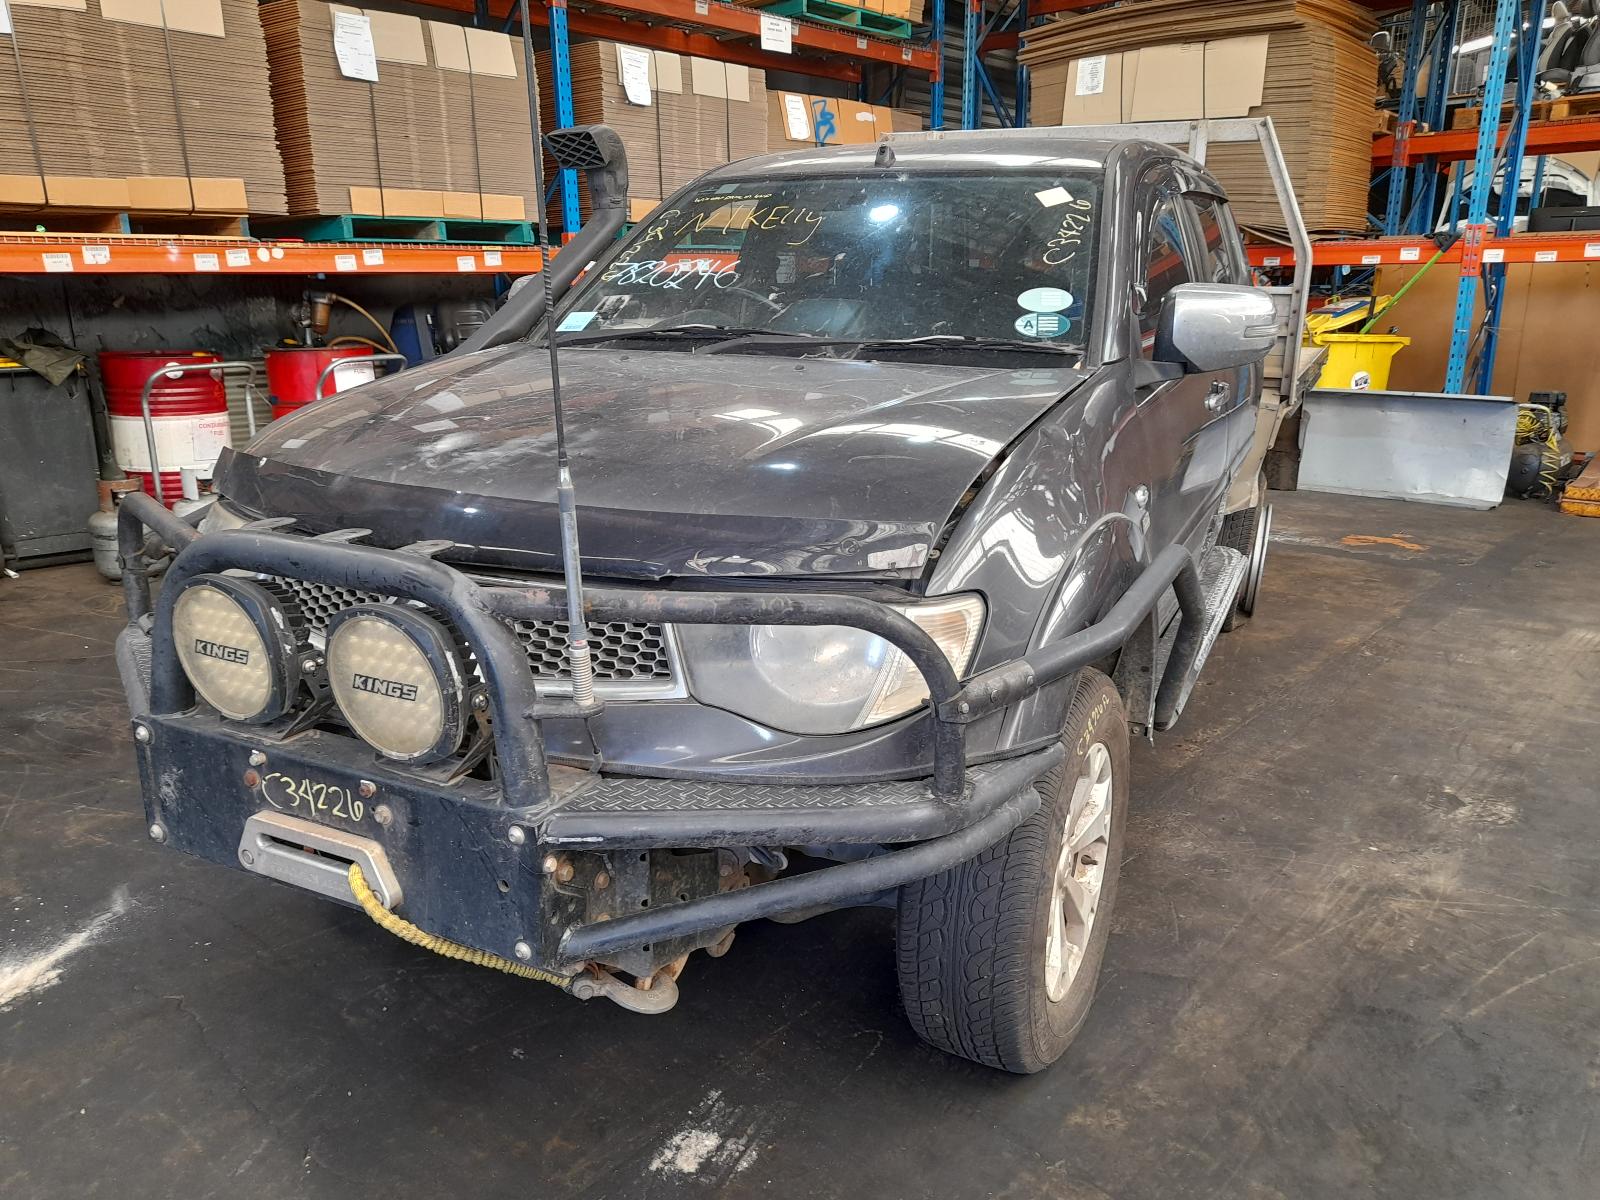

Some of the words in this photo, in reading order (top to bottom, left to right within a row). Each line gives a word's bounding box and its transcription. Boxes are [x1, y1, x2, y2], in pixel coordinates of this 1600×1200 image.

[1042, 199, 1092, 265] C34226
[195, 639, 249, 665] KINGS
[352, 673, 418, 701] KINGS
[262, 773, 364, 822] C34226
